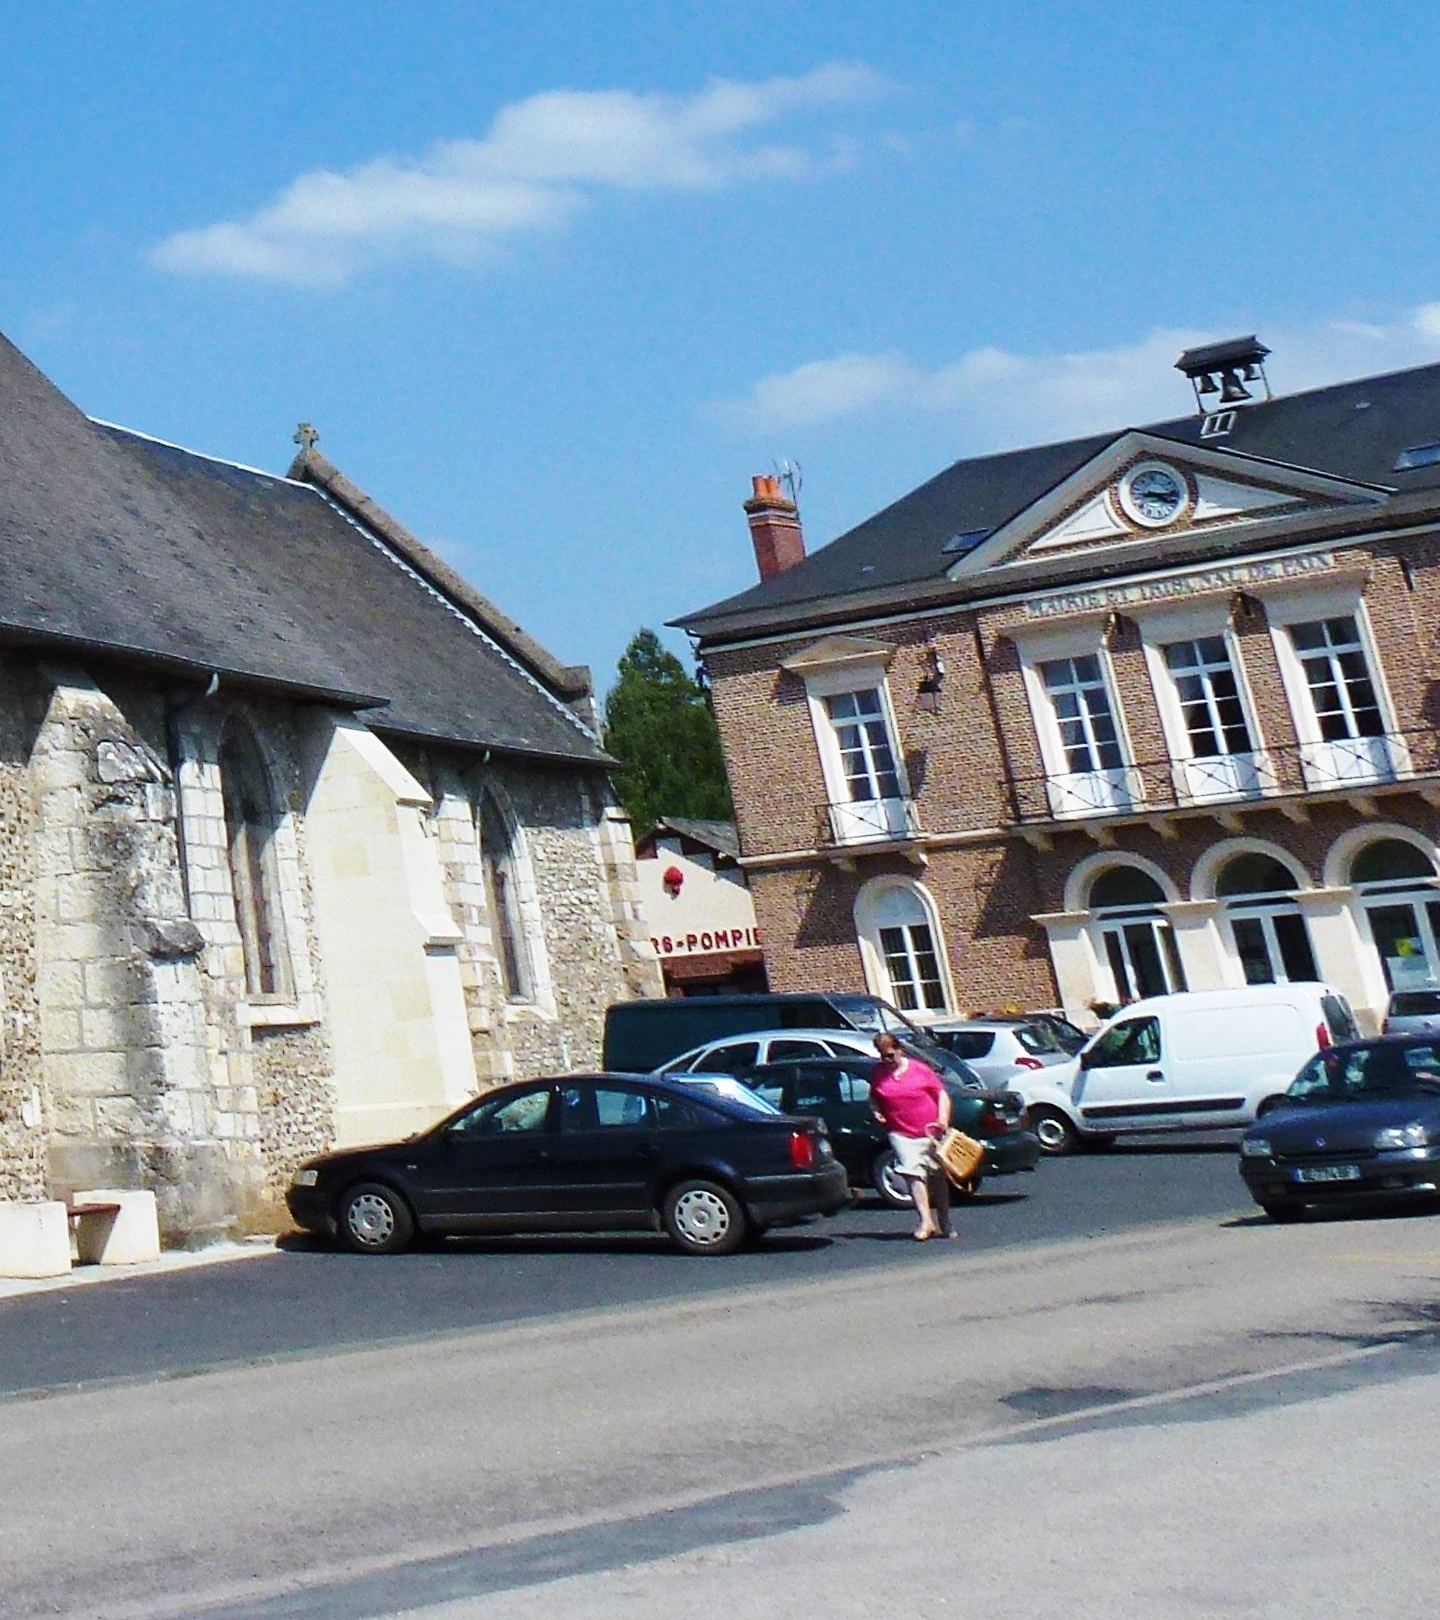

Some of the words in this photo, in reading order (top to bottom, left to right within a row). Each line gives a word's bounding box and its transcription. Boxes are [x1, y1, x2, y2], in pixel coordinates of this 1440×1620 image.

[1026, 591, 1100, 618] MAIRIE
[1106, 588, 1128, 607] ET
[1140, 566, 1239, 600] TRIBUNAL
[1249, 561, 1273, 582] DE
[1283, 552, 1330, 576] PAIX
